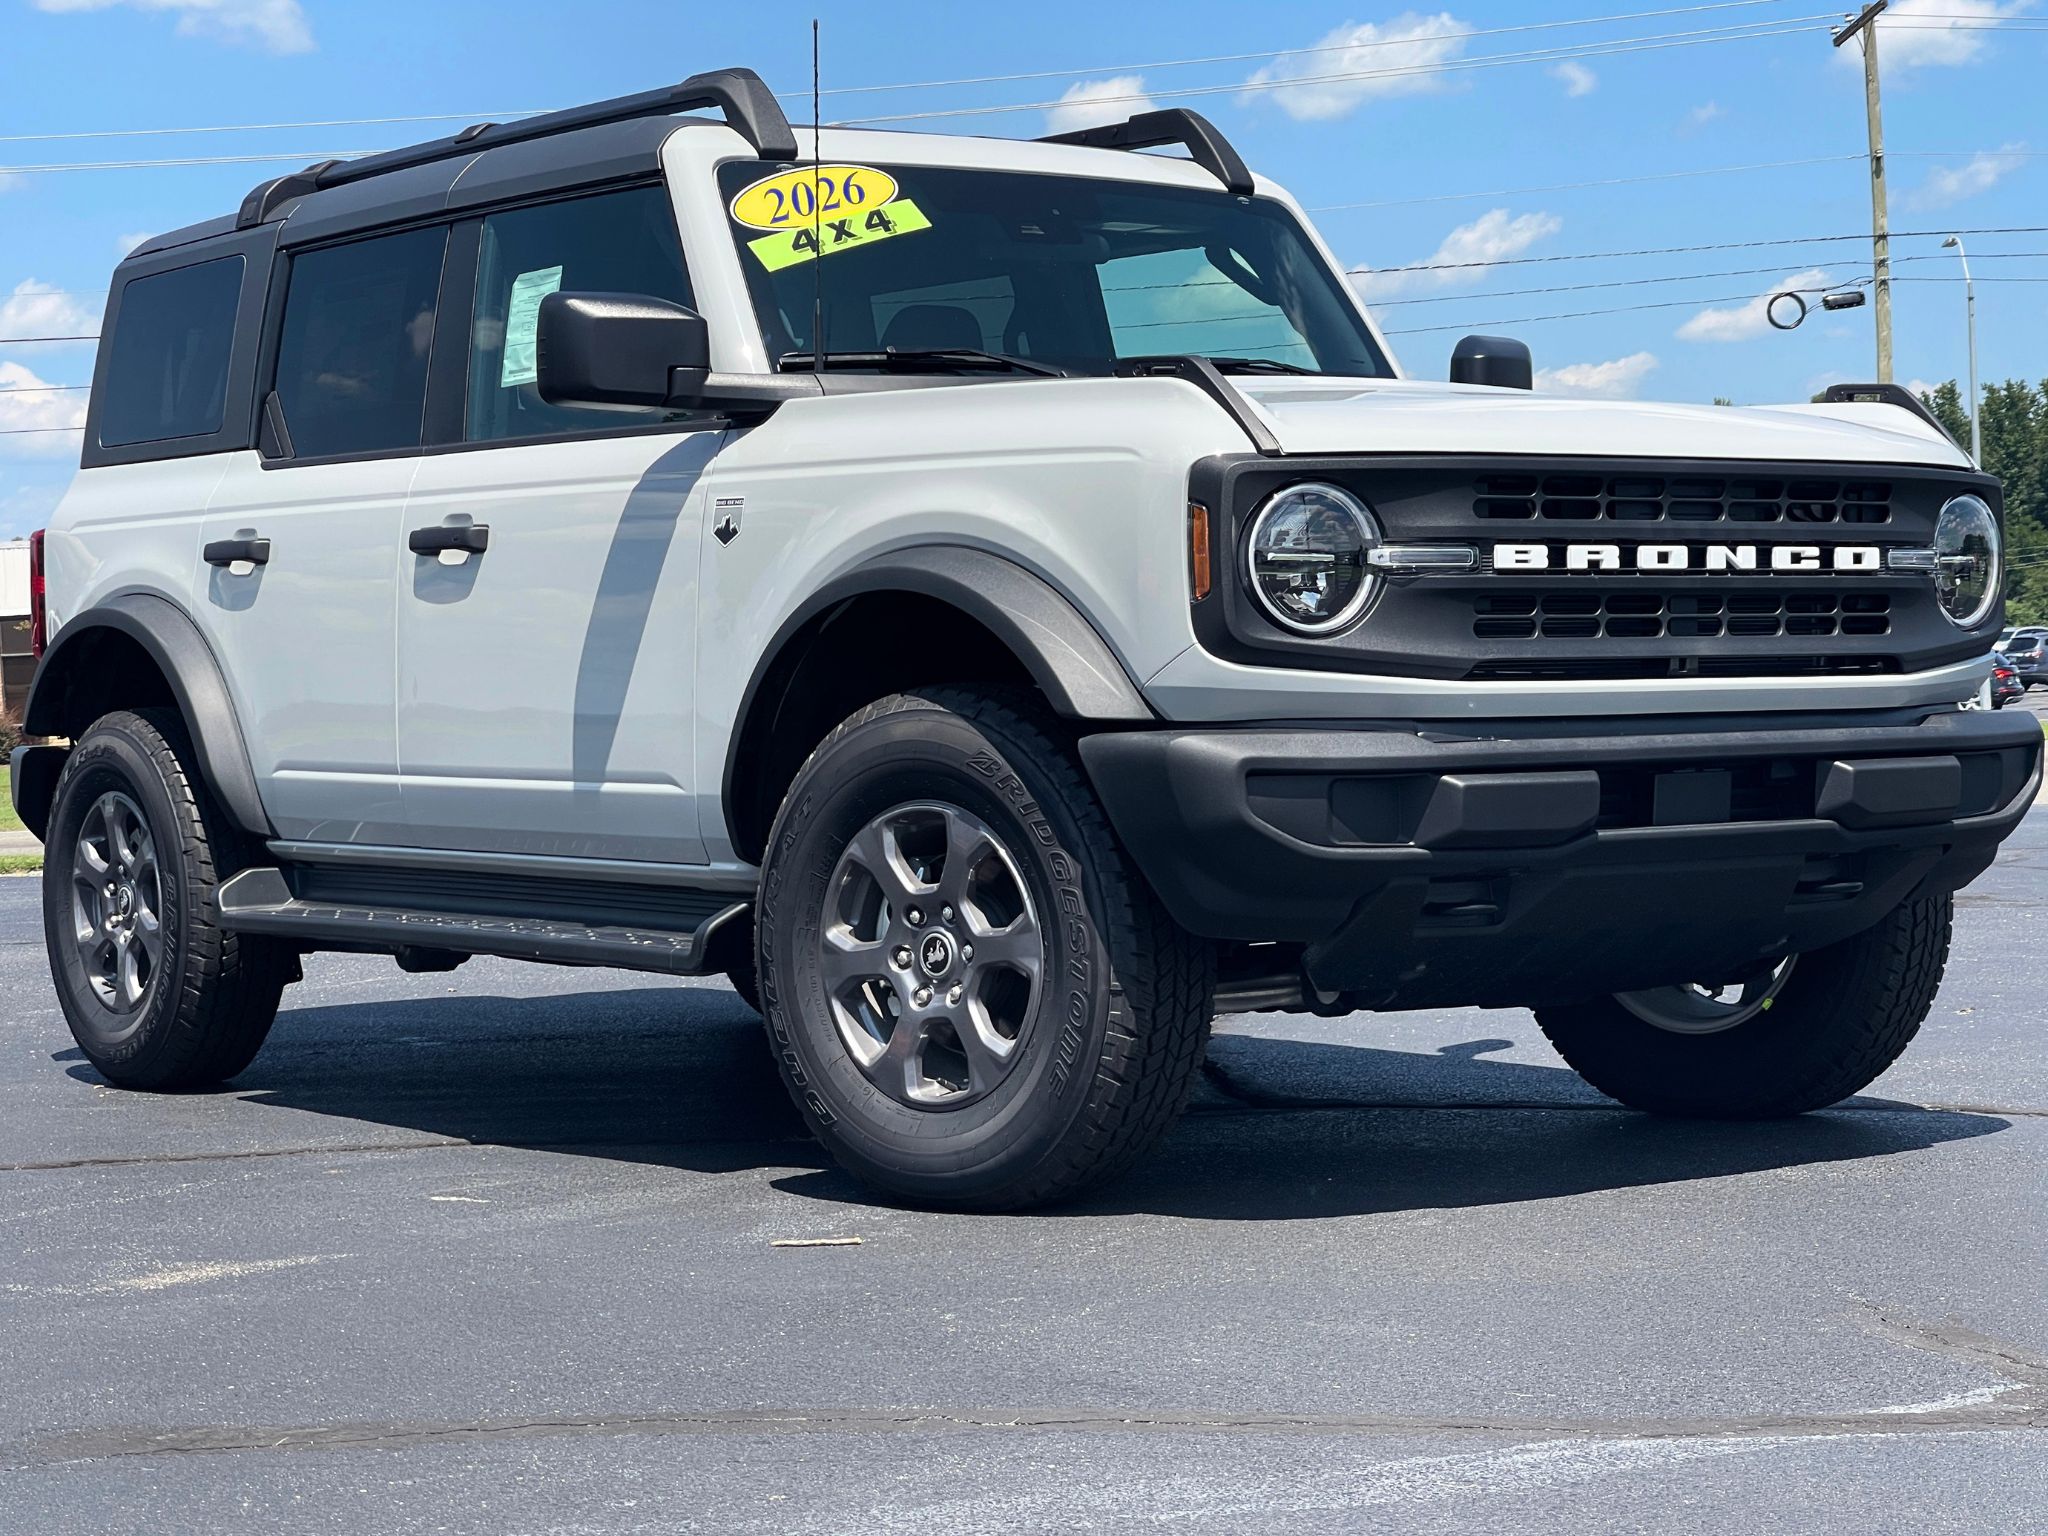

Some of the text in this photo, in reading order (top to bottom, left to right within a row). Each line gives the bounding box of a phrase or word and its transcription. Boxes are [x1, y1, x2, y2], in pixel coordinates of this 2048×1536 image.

[764, 172, 865, 224] 2026
[1493, 543, 1880, 570] BRONCO
[965, 749, 1092, 1099] BRIDGESTONE
